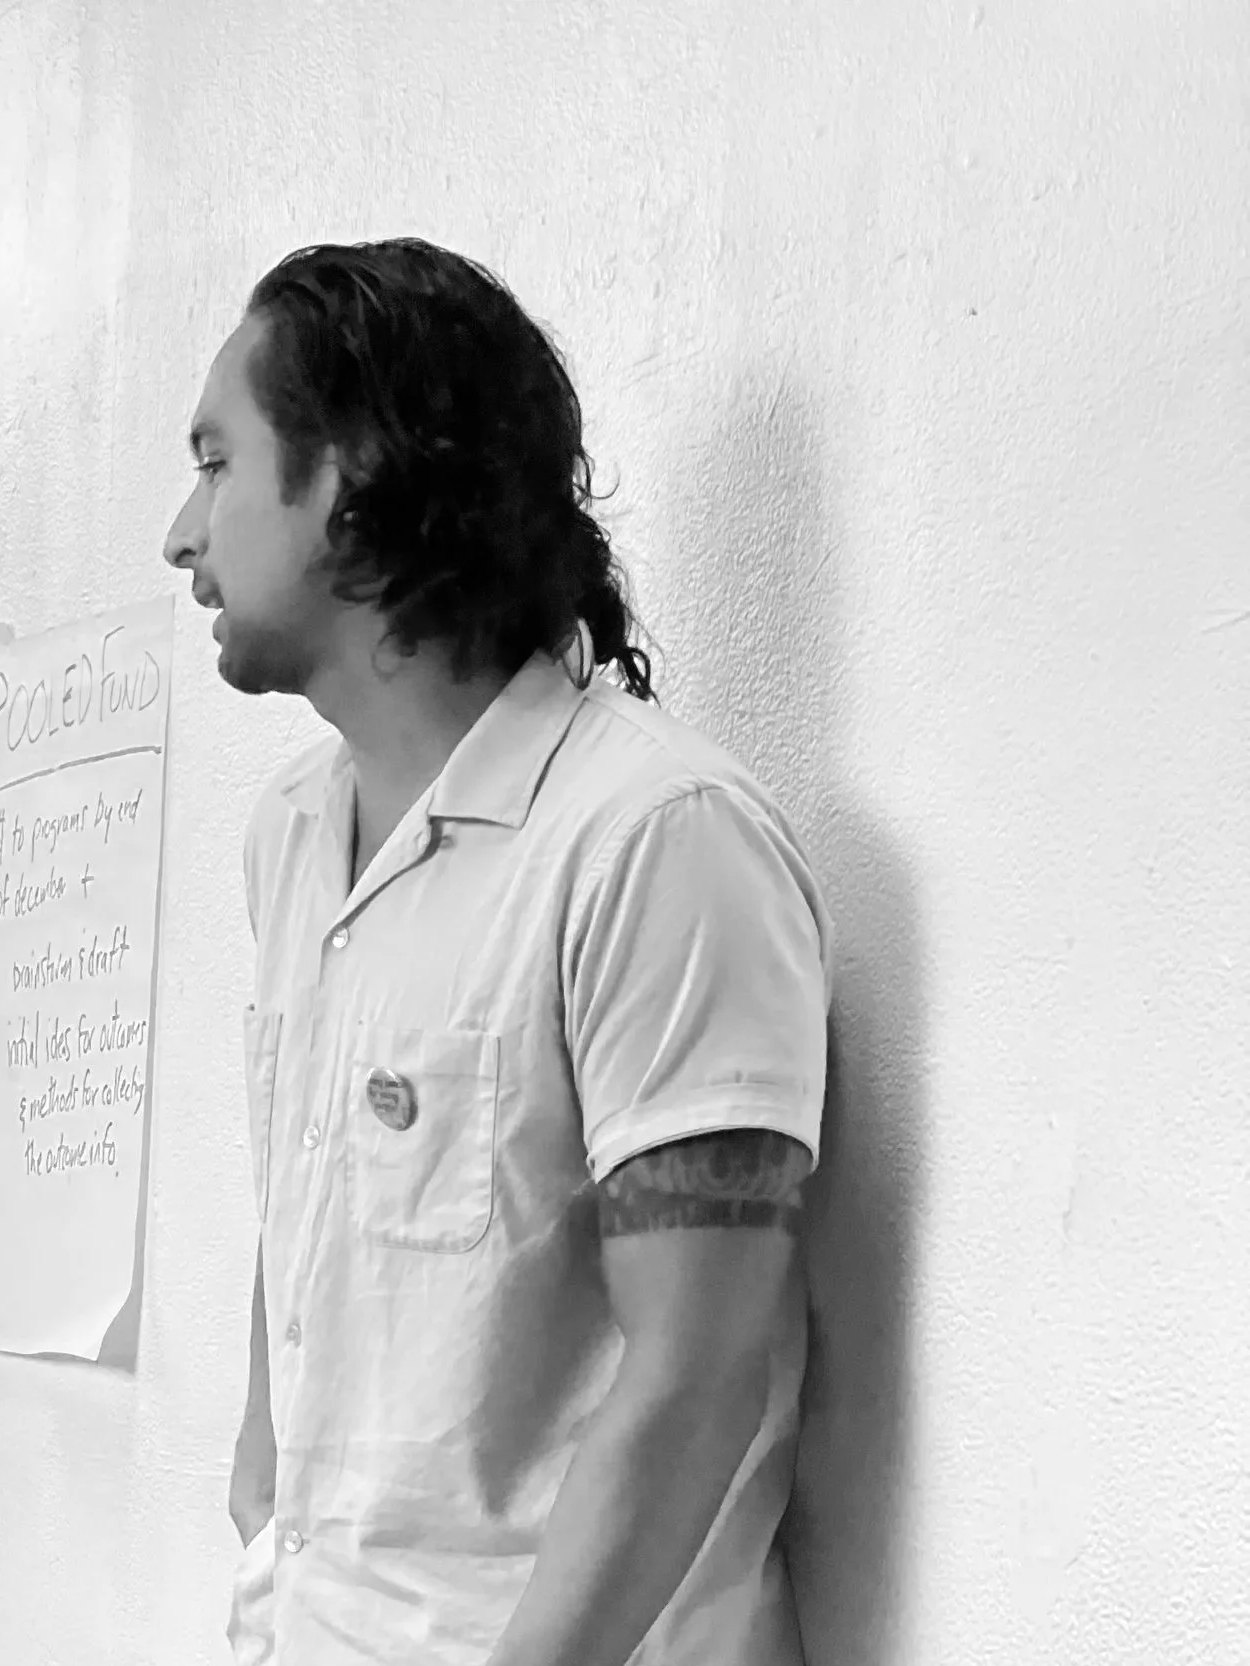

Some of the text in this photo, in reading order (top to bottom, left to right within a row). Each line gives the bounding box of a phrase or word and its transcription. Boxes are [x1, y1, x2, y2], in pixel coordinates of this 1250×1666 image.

[12, 814, 24, 856] to
[31, 805, 88, 863] programs
[94, 791, 112, 844] by
[119, 788, 143, 824] end
[88, 924, 130, 977] draft
[78, 1014, 95, 1058] for
[30, 1074, 78, 1120] methods
[82, 1068, 99, 1108] for
[25, 1138, 42, 1176] the
